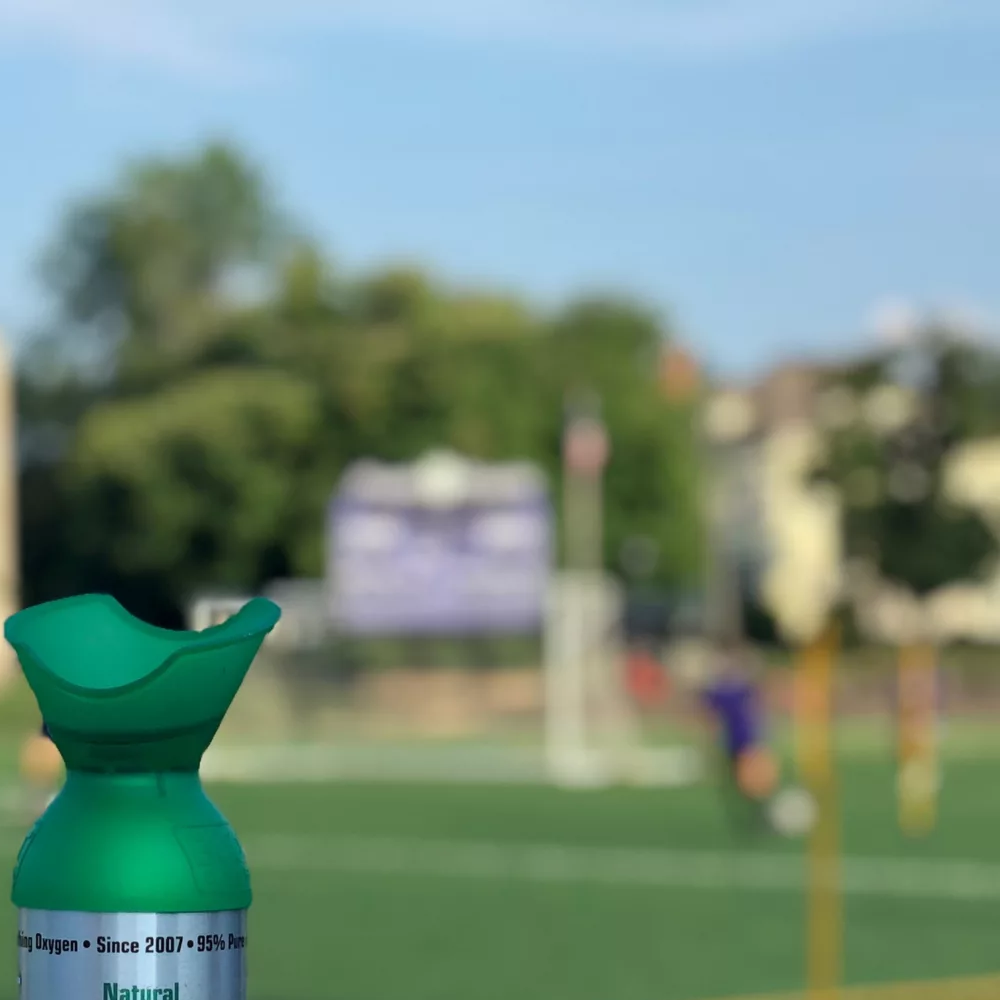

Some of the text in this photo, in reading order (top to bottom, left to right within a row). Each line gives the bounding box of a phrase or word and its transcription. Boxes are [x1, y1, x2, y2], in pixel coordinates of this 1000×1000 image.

[36, 933, 78, 955] Oxygen
[97, 936, 139, 953] Since
[145, 936, 183, 953] 2007
[197, 934, 226, 951] 95%
